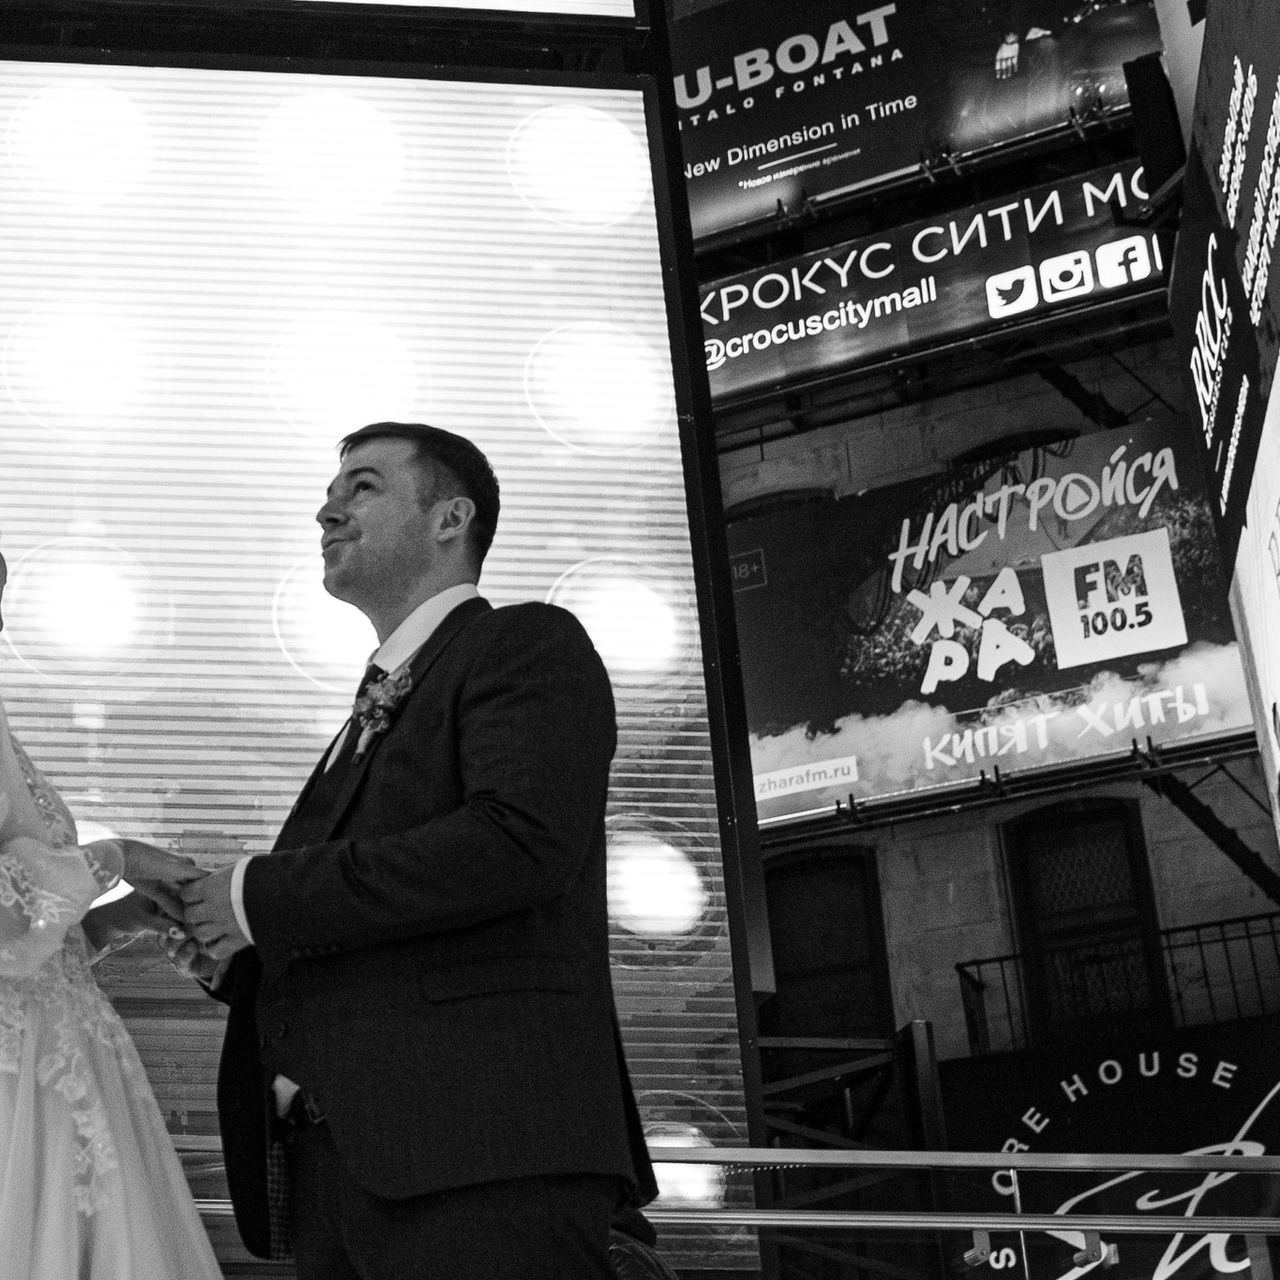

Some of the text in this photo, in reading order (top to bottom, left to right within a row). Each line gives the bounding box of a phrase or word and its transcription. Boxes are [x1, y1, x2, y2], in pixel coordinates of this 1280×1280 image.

[673, 2, 897, 110] U-BOAT
[678, 48, 904, 131] ITALO FONTANA
[727, 121, 835, 166] Dimension
[841, 114, 860, 130] in
[865, 94, 918, 121] Time
[912, 190, 1065, 264] СИТИ
[704, 275, 937, 371] @crocuscitymall
[888, 438, 1179, 593] НАСТРОЙСЯ
[1073, 553, 1149, 610] FM
[1080, 601, 1153, 639] 100.5
[923, 683, 1210, 770] КИПЯТ ХИТЫ
[757, 764, 852, 794] zharafm.ru
[989, 1106, 1050, 1270] SORE
[1060, 1051, 1238, 1103] HOUSE
